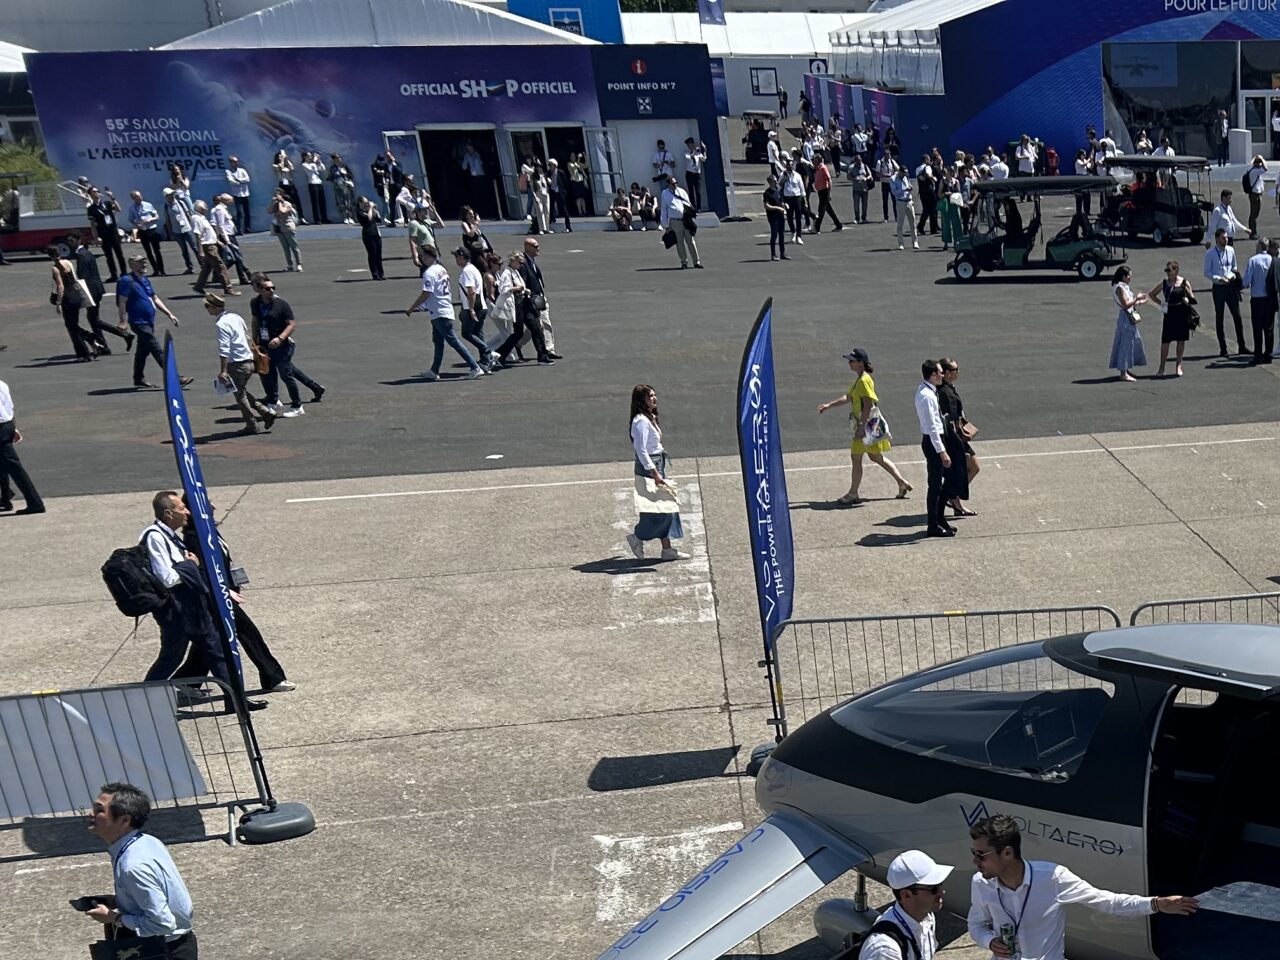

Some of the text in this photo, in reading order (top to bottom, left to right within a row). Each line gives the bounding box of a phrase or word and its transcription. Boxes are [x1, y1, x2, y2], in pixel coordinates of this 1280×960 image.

[1164, 0, 1277, 11] POUR LE FUTUR
[400, 83, 458, 96] OFFICIAL
[521, 82, 577, 94] OFFICIEL
[607, 82, 635, 91] POINT
[637, 82, 659, 90] INFO
[132, 117, 180, 130] SALON
[108, 130, 219, 144] INTERNATIONAL
[766, 514, 779, 567] POWER
[773, 568, 785, 598] THE
